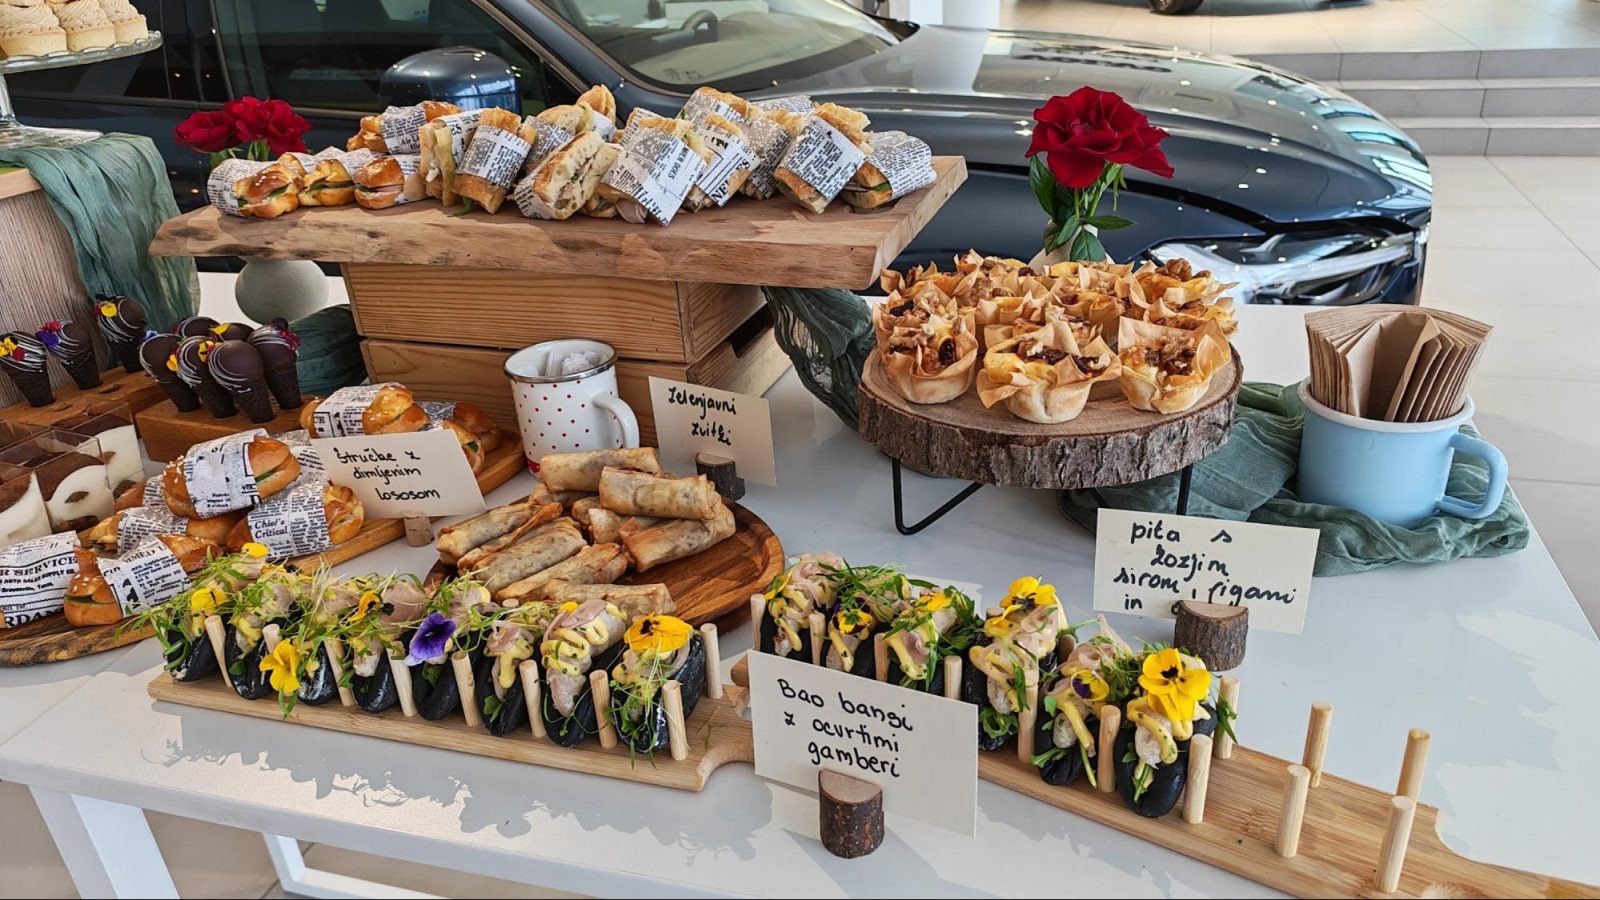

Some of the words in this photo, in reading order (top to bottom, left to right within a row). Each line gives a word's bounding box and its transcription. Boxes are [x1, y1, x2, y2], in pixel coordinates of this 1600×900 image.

[353, 464, 421, 485] dimljenim
[375, 488, 440, 501] lososom
[254, 525, 288, 539] Critical
[1130, 520, 1180, 544] pita
[14, 556, 78, 577] SERVICE
[1124, 594, 1143, 610] in
[777, 678, 825, 708] Bao
[812, 718, 899, 752] ocvrtimi
[808, 741, 900, 777] gamberi
